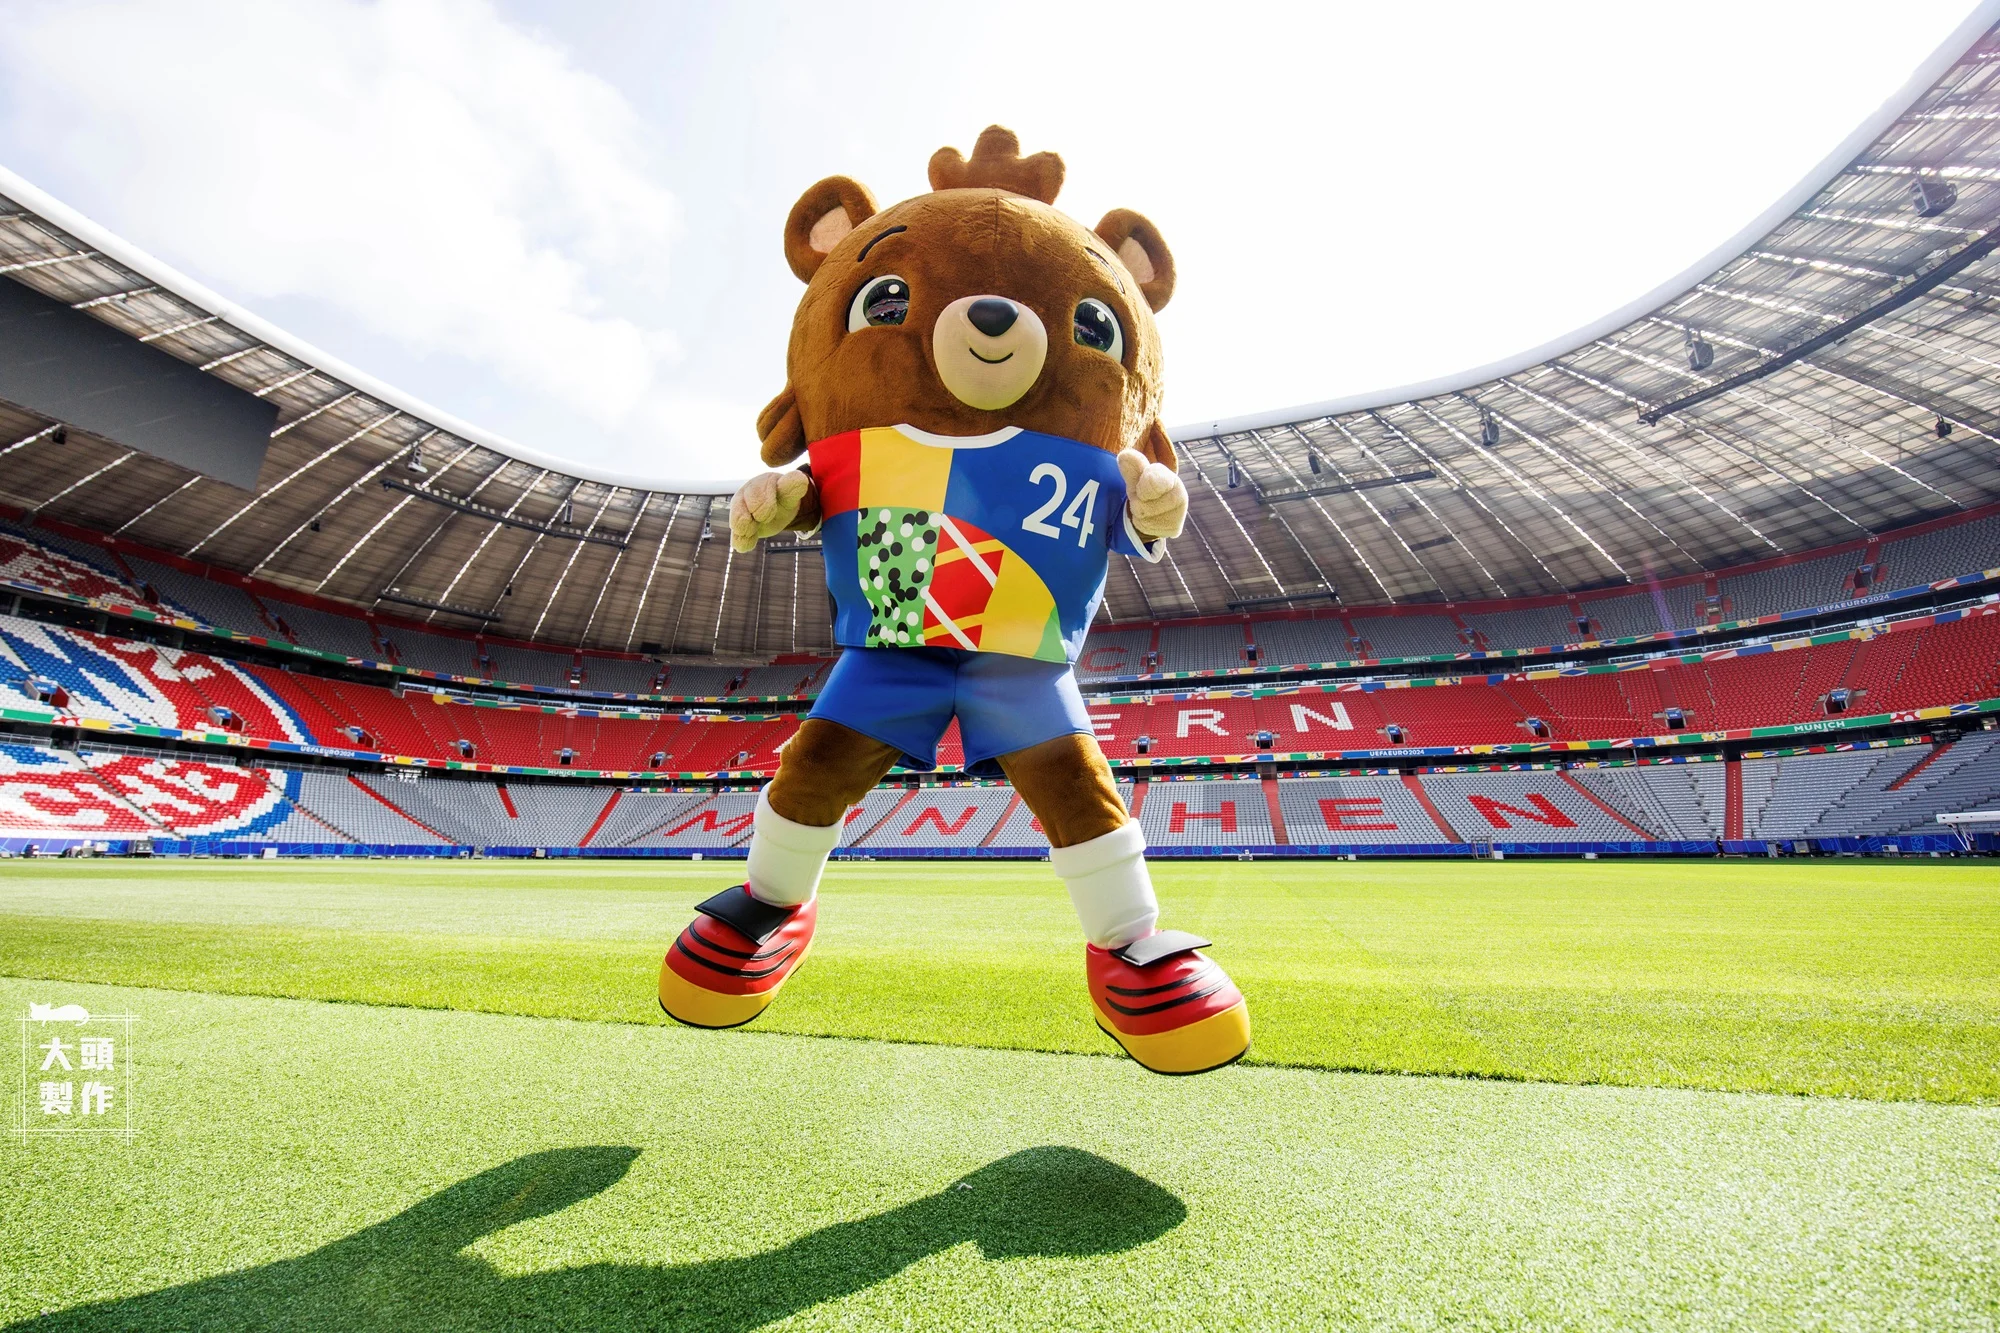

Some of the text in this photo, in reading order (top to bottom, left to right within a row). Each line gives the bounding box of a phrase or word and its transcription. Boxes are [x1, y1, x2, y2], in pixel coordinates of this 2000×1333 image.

[1022, 462, 1100, 549] 24
[292, 645, 323, 658] MUNICH
[1793, 720, 1846, 733] MUNICH
[547, 769, 577, 777] MUNICH
[664, 793, 1579, 837] MNHEN
